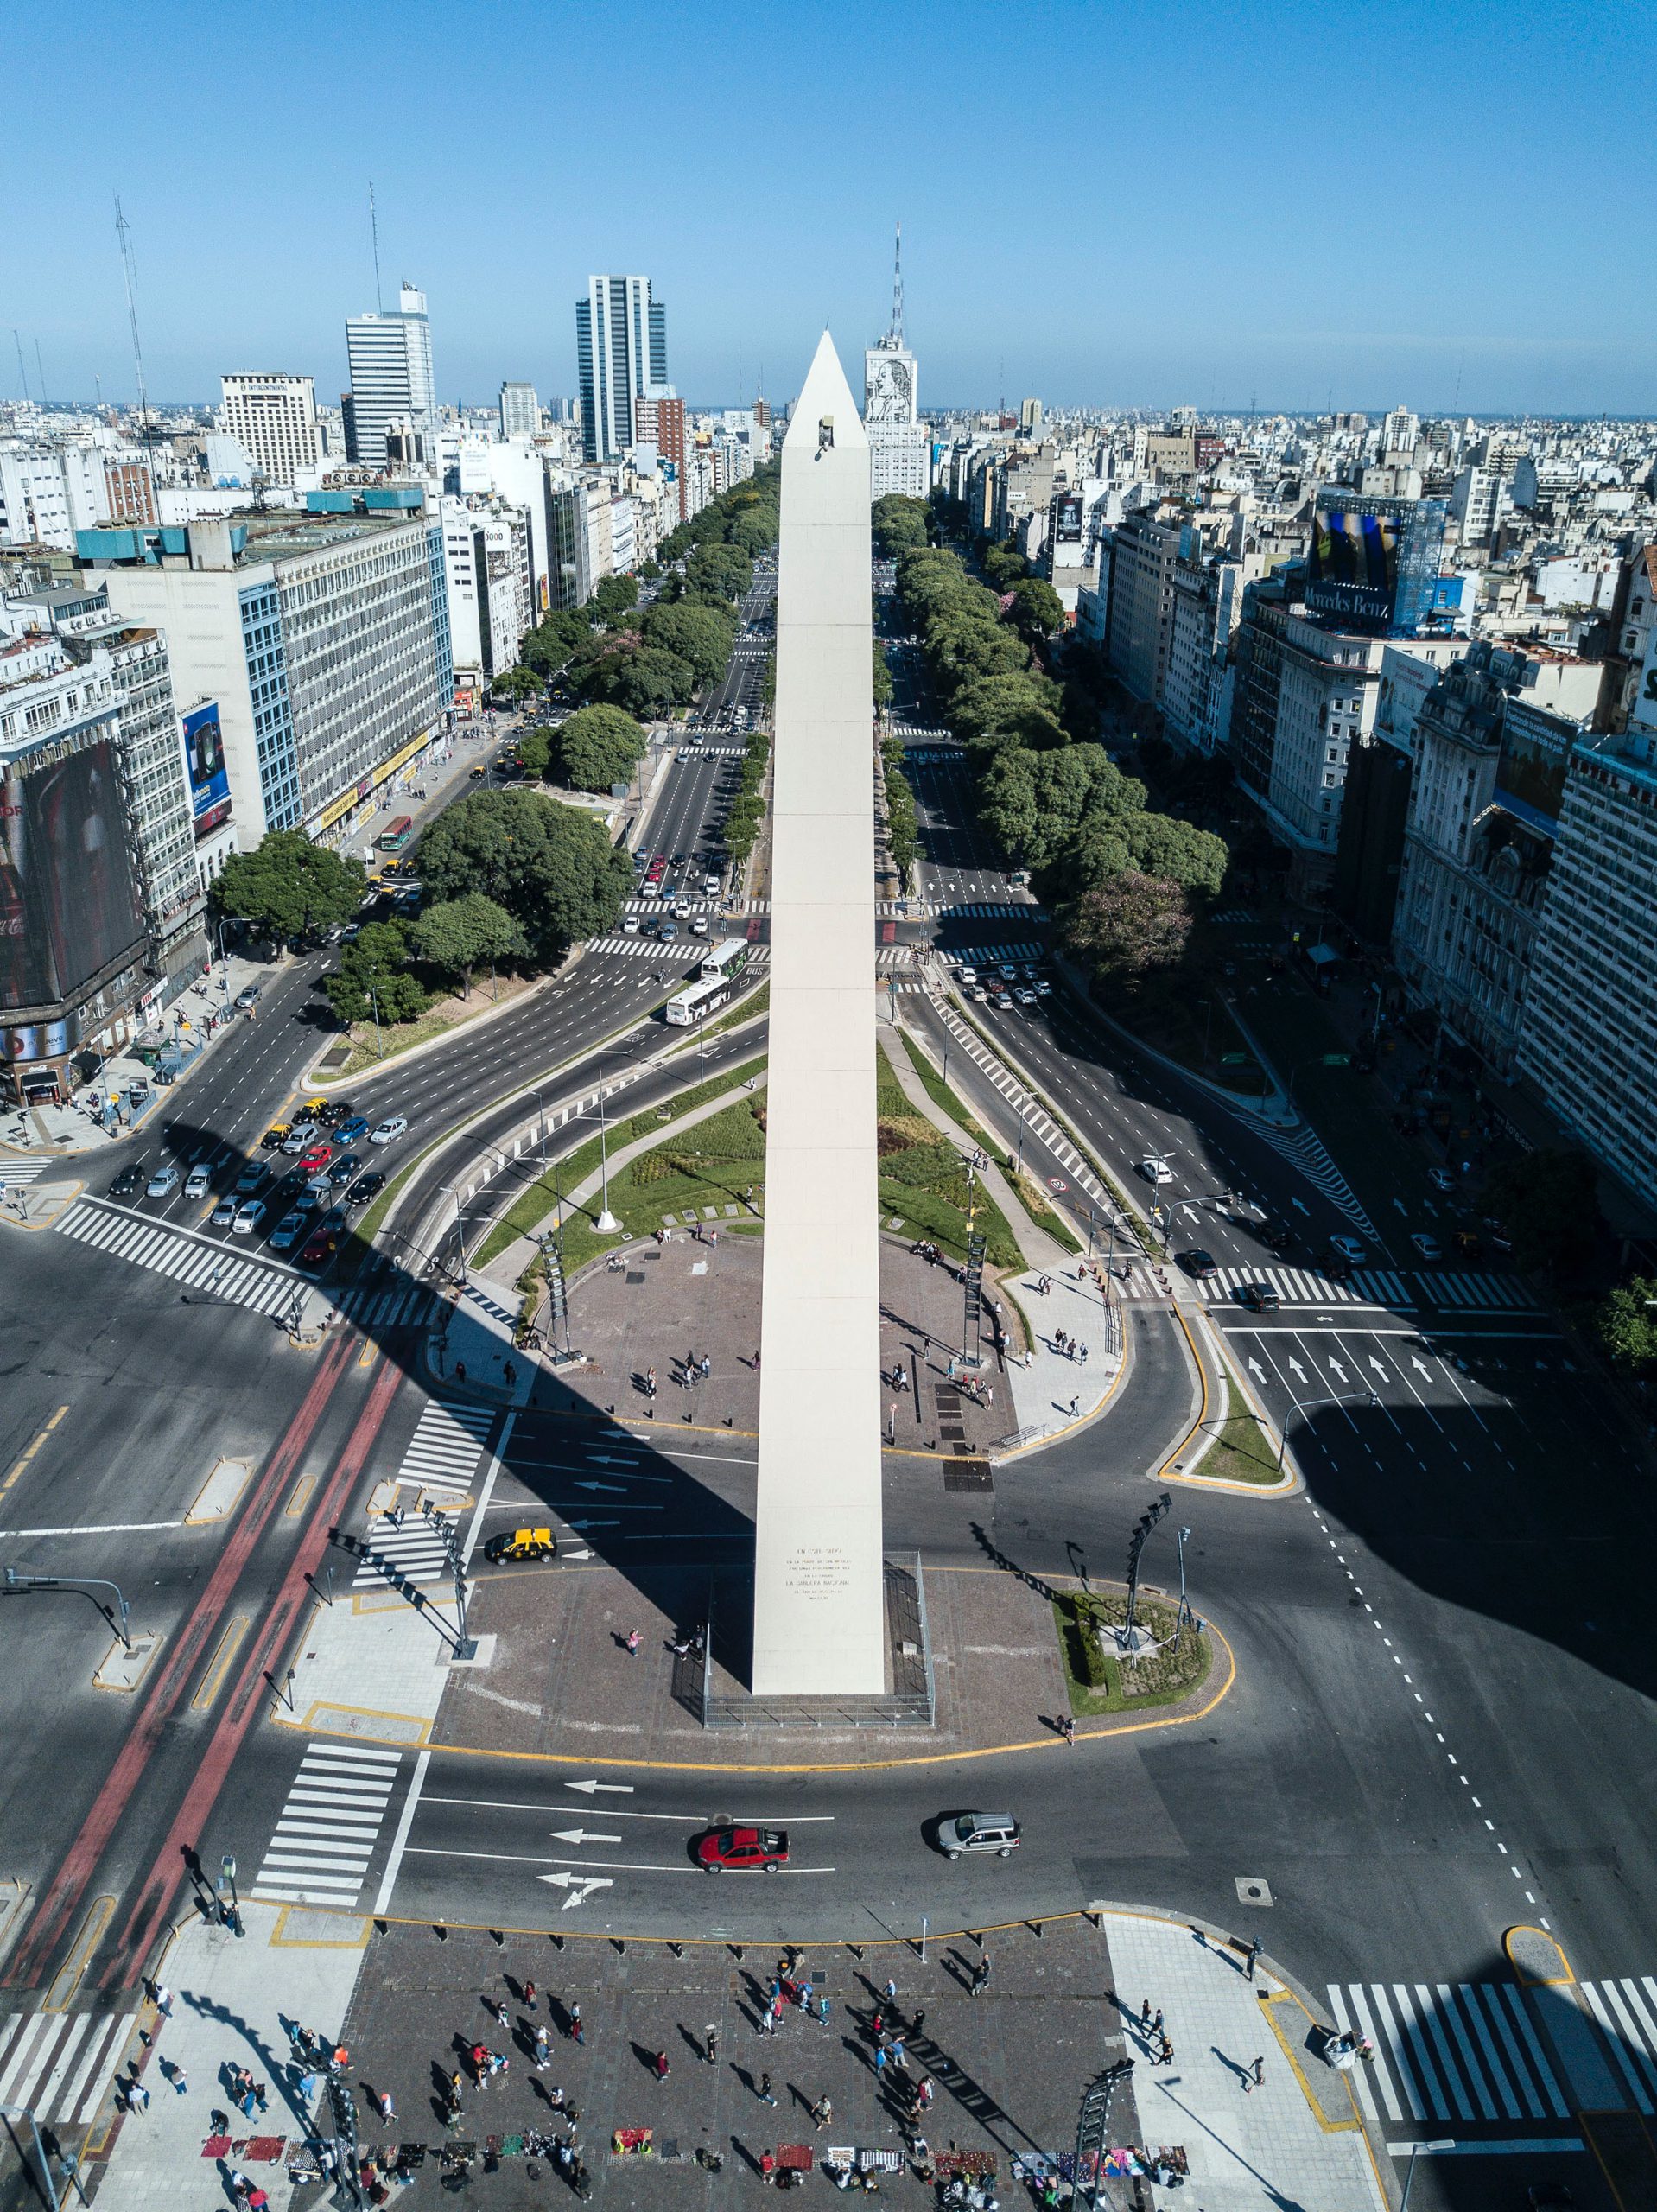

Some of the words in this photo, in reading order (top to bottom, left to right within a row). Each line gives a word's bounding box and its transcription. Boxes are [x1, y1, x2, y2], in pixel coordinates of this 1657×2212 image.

[1304, 586, 1350, 612] Mercedes
[1353, 594, 1388, 618] Benz
[746, 967, 764, 976] BUS
